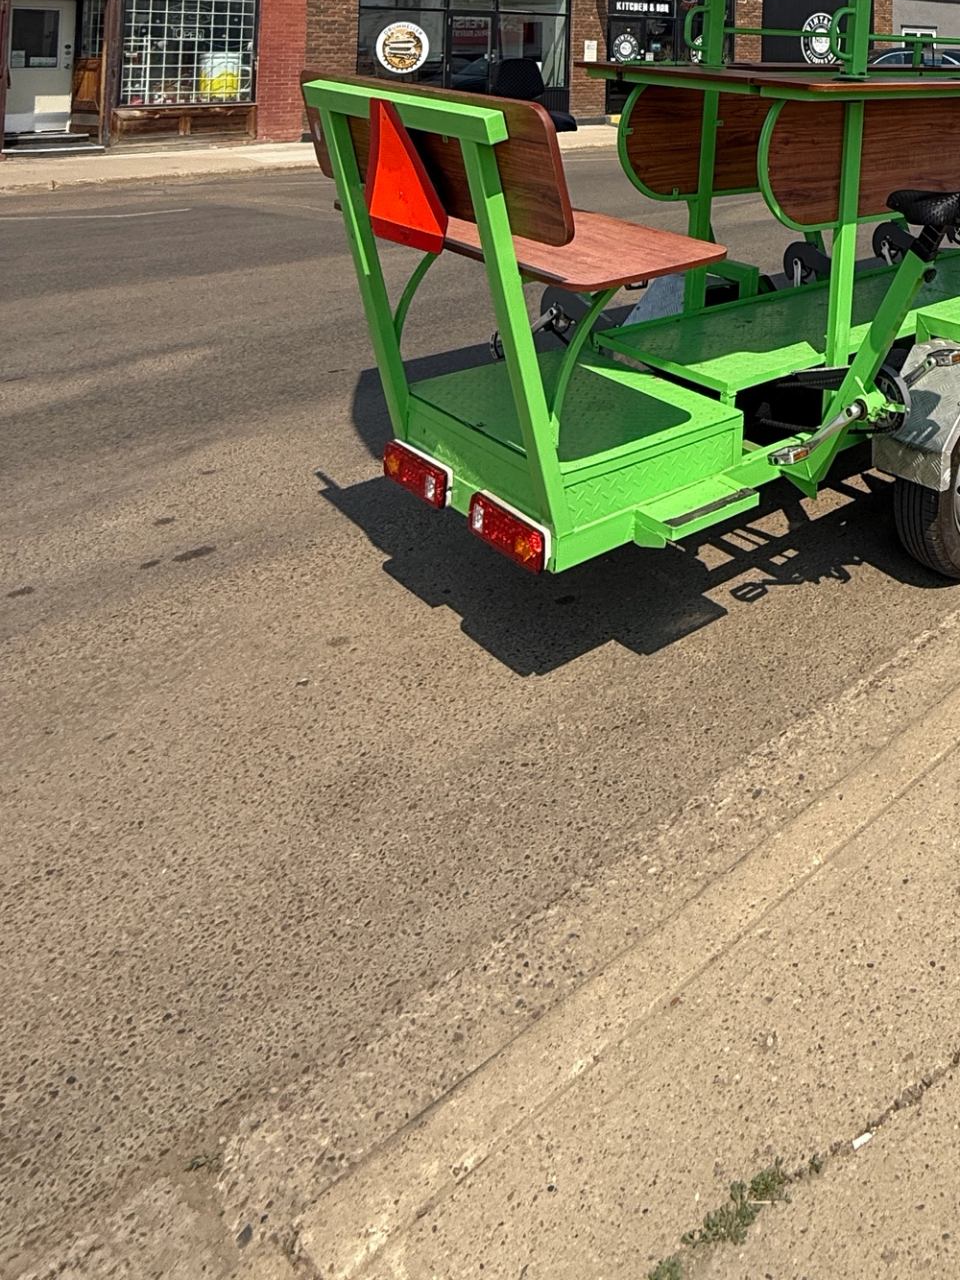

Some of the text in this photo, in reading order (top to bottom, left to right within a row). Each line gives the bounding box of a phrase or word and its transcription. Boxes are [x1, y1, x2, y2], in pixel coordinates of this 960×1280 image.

[616, 1, 648, 12] KITCHEN
[649, 3, 656, 12] &
[804, 16, 832, 31] VINTA
